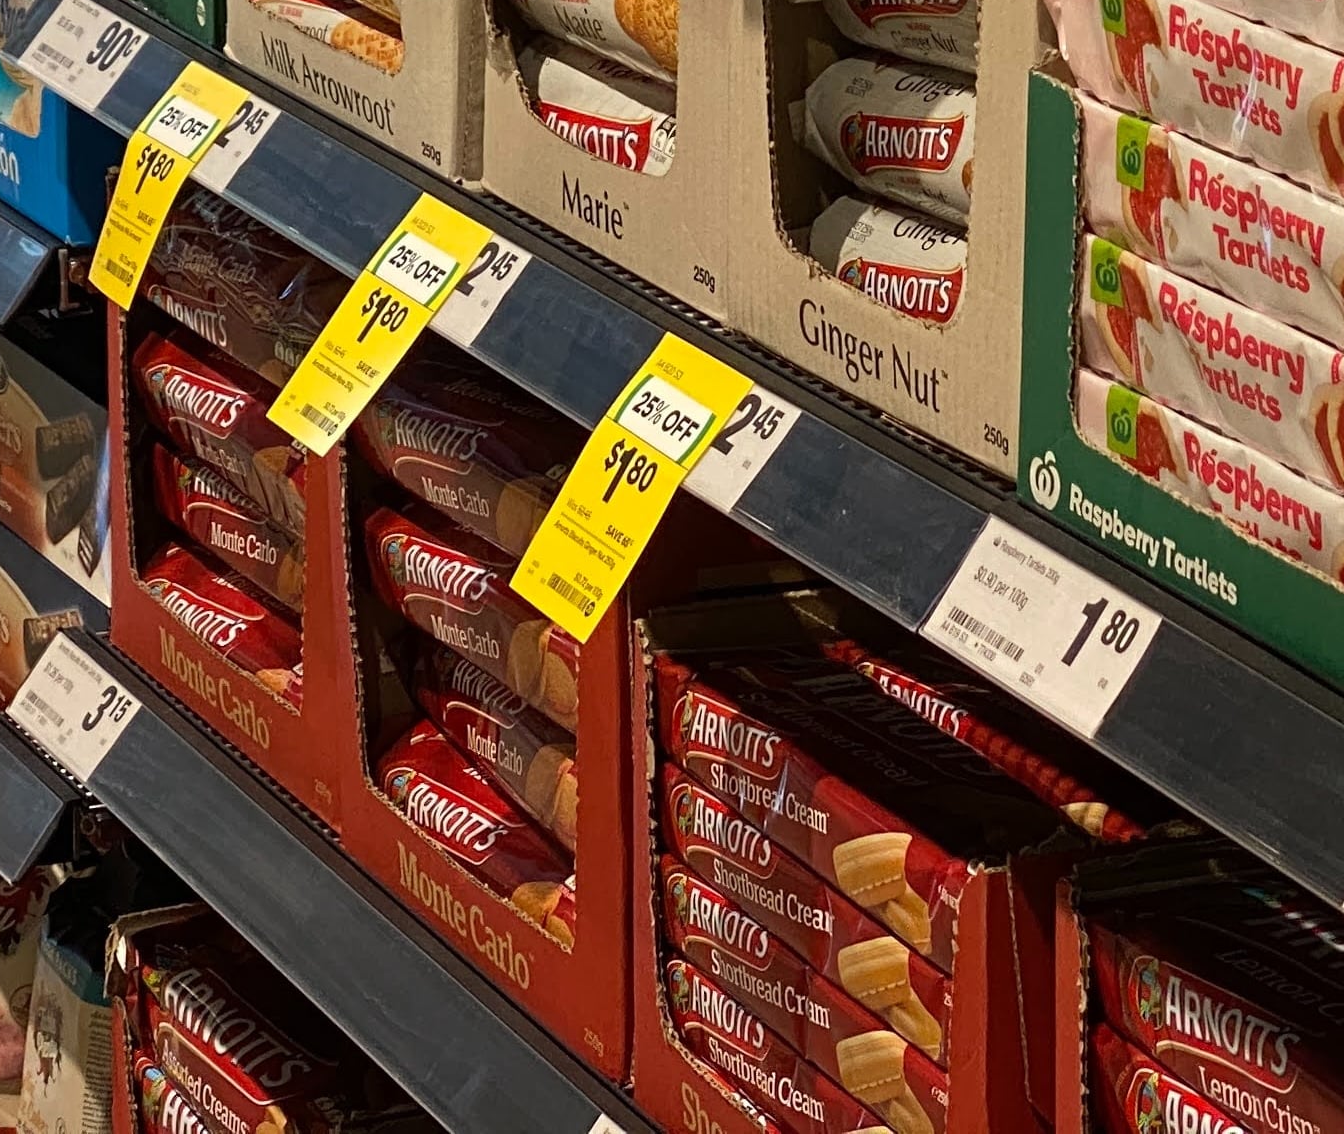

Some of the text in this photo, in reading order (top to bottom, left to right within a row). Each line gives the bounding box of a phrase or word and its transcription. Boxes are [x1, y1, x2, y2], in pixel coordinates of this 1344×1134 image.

[260, 31, 394, 136] Milk Arrowroot
[1168, 5, 1304, 110] Raspberry
[180, 118, 208, 140] OFF
[421, 141, 441, 165] 250g
[866, 120, 952, 162] ARNOTT'S
[563, 170, 624, 239] Marie
[1189, 158, 1325, 267] Raspberry
[413, 260, 445, 288] OFF
[694, 266, 715, 293] 250g
[1213, 225, 1311, 293] Tartlets
[800, 298, 941, 413] Ginger Nut
[1159, 281, 1305, 395] Raspberry
[662, 409, 700, 442] OFF
[984, 424, 1010, 456] 250g
[1183, 430, 1322, 552] Raspberry
[246, 535, 278, 565] Carlo
[1069, 482, 1238, 606] Raspberry Tartlets
[994, 581, 1008, 597] per
[1009, 587, 1028, 611] 100g
[467, 628, 499, 658] Carlo
[160, 627, 270, 749] Monte Carlo
[467, 724, 522, 775] Monte Carlo
[398, 841, 530, 989] Monte Carlo
[1166, 976, 1301, 1077] ARNOTT'S
[1198, 1066, 1263, 1122] Lemon
